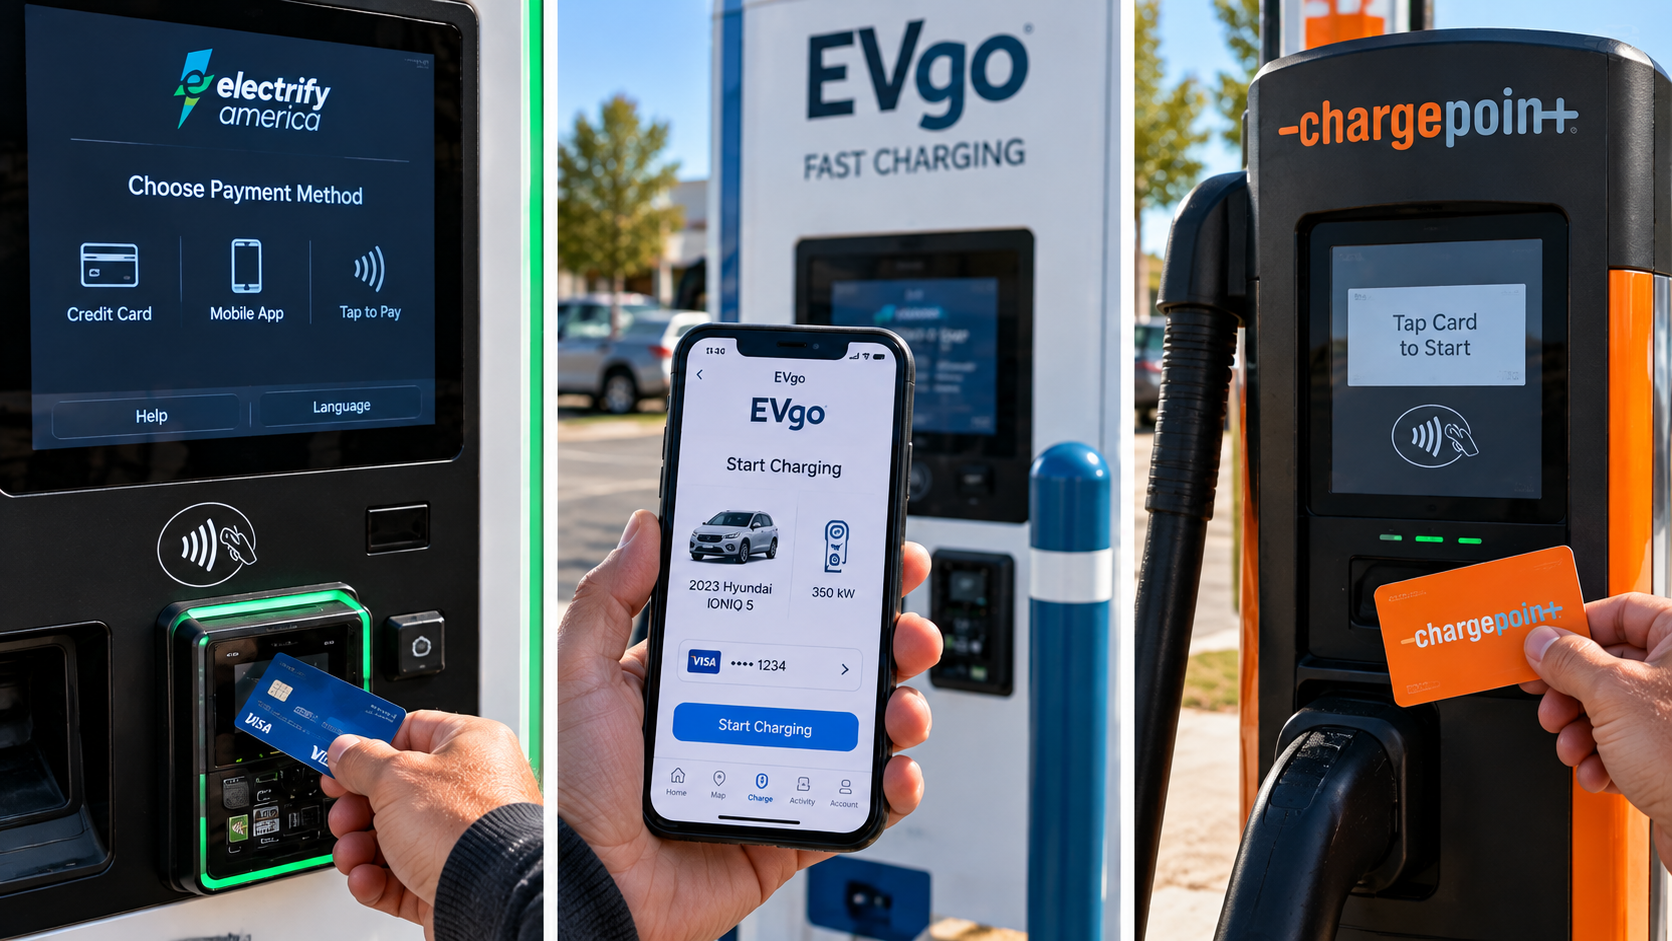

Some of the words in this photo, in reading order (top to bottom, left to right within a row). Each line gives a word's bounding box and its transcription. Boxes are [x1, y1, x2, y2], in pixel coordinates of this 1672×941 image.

[807, 19, 1029, 131] EVgo
[216, 71, 331, 111] electrify
[219, 105, 321, 131] america
[804, 150, 866, 181] FAST
[873, 137, 1026, 176] CHARGING
[128, 175, 205, 199] Choose
[210, 180, 292, 204] Payment
[297, 184, 363, 205] Method
[67, 306, 113, 322] Credit
[117, 305, 152, 321] Card
[210, 306, 254, 321] Mobile
[257, 306, 284, 324] App
[339, 305, 361, 322] Tap
[364, 305, 377, 319] to
[380, 305, 402, 322] Pay
[1392, 314, 1427, 335] Tap
[1432, 312, 1478, 332] Card
[1399, 340, 1419, 356] to
[1424, 338, 1471, 357] Start
[774, 371, 806, 386] EVgo
[136, 408, 168, 425] Help
[313, 400, 371, 416] Language
[750, 397, 826, 431] EVgo
[726, 457, 766, 472] Start
[770, 459, 842, 479] Charging
[689, 580, 720, 592] 2023
[723, 581, 773, 596] Hyundai
[811, 587, 834, 599] 350
[837, 587, 856, 599] kW
[707, 598, 743, 612] IONIQ
[745, 600, 755, 611] 5
[691, 655, 717, 668] VISA
[757, 659, 787, 672] 1234
[244, 712, 273, 735] VISA
[718, 718, 751, 732] Start
[753, 720, 813, 738] Charging
[666, 788, 688, 797] Home
[710, 790, 727, 801] Map
[747, 793, 774, 804] Charge
[789, 796, 816, 807] Activity
[829, 799, 859, 809] Account
